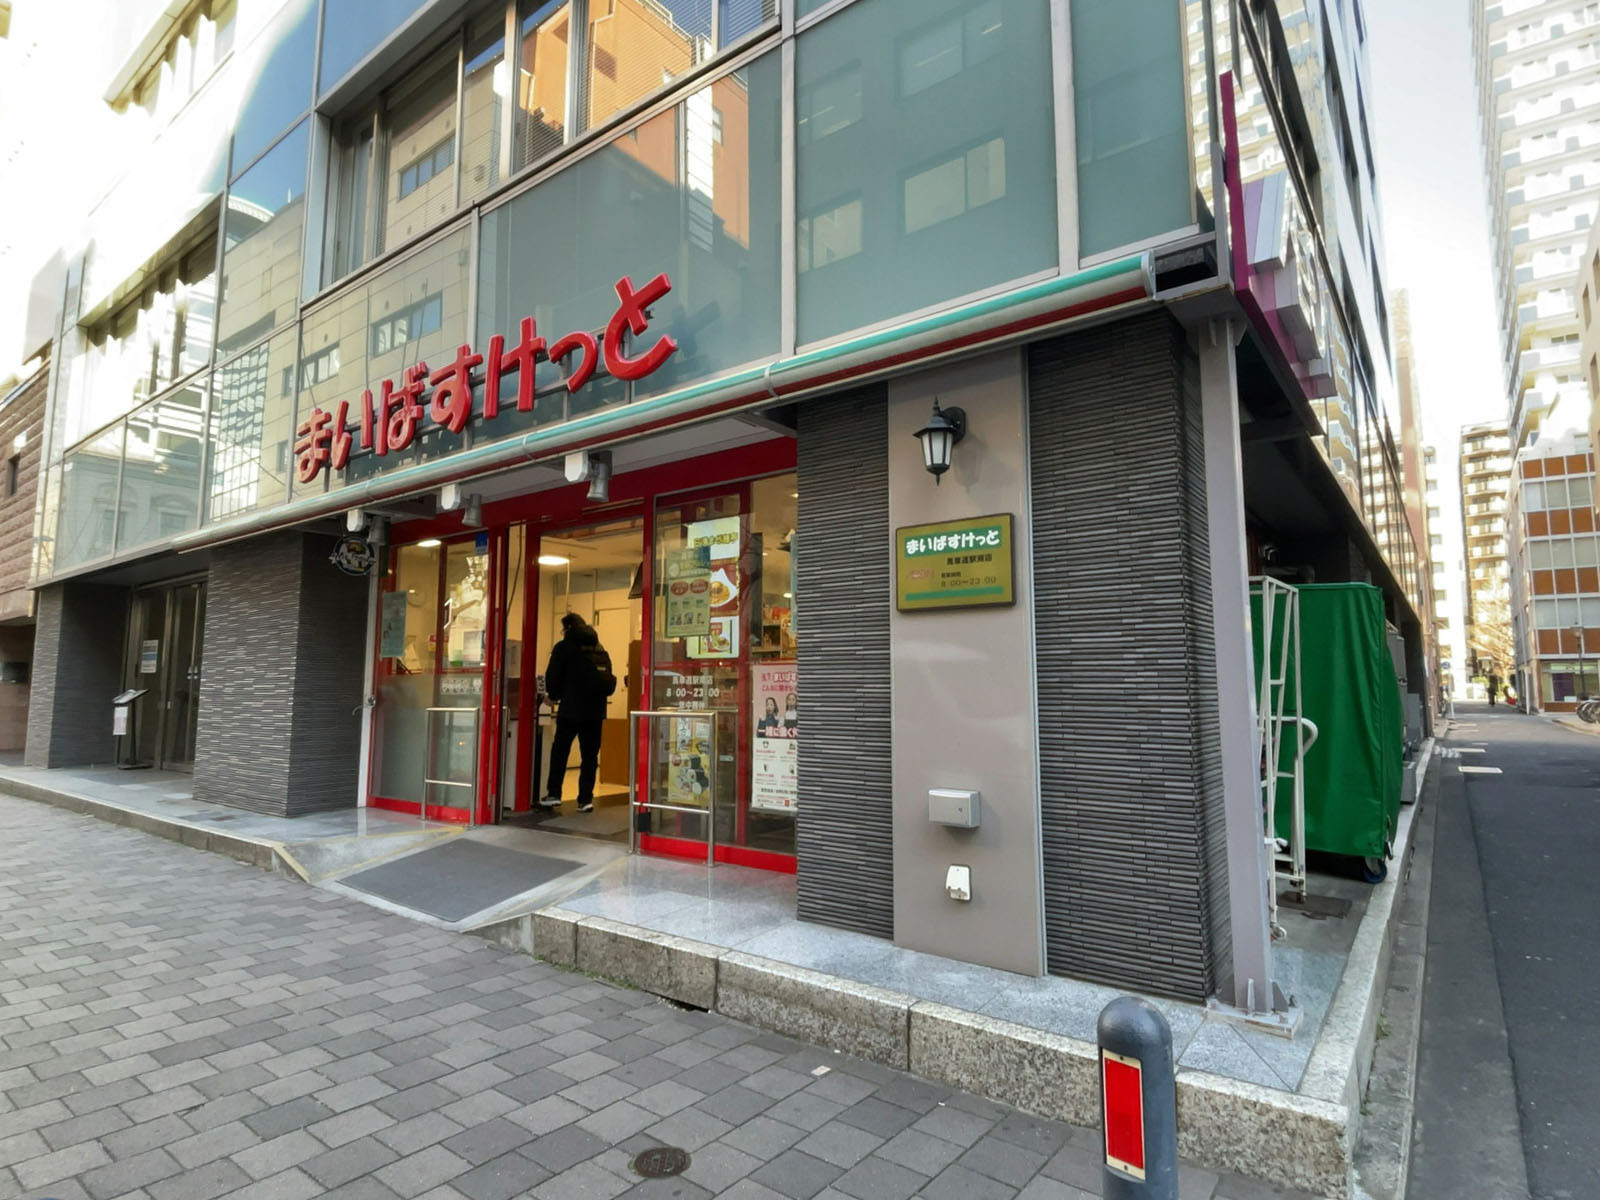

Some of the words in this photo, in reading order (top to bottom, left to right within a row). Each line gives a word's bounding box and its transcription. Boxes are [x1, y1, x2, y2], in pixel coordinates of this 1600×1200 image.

[294, 272, 678, 484] まいばすけっと
[906, 530, 999, 554] まいばすけっと
